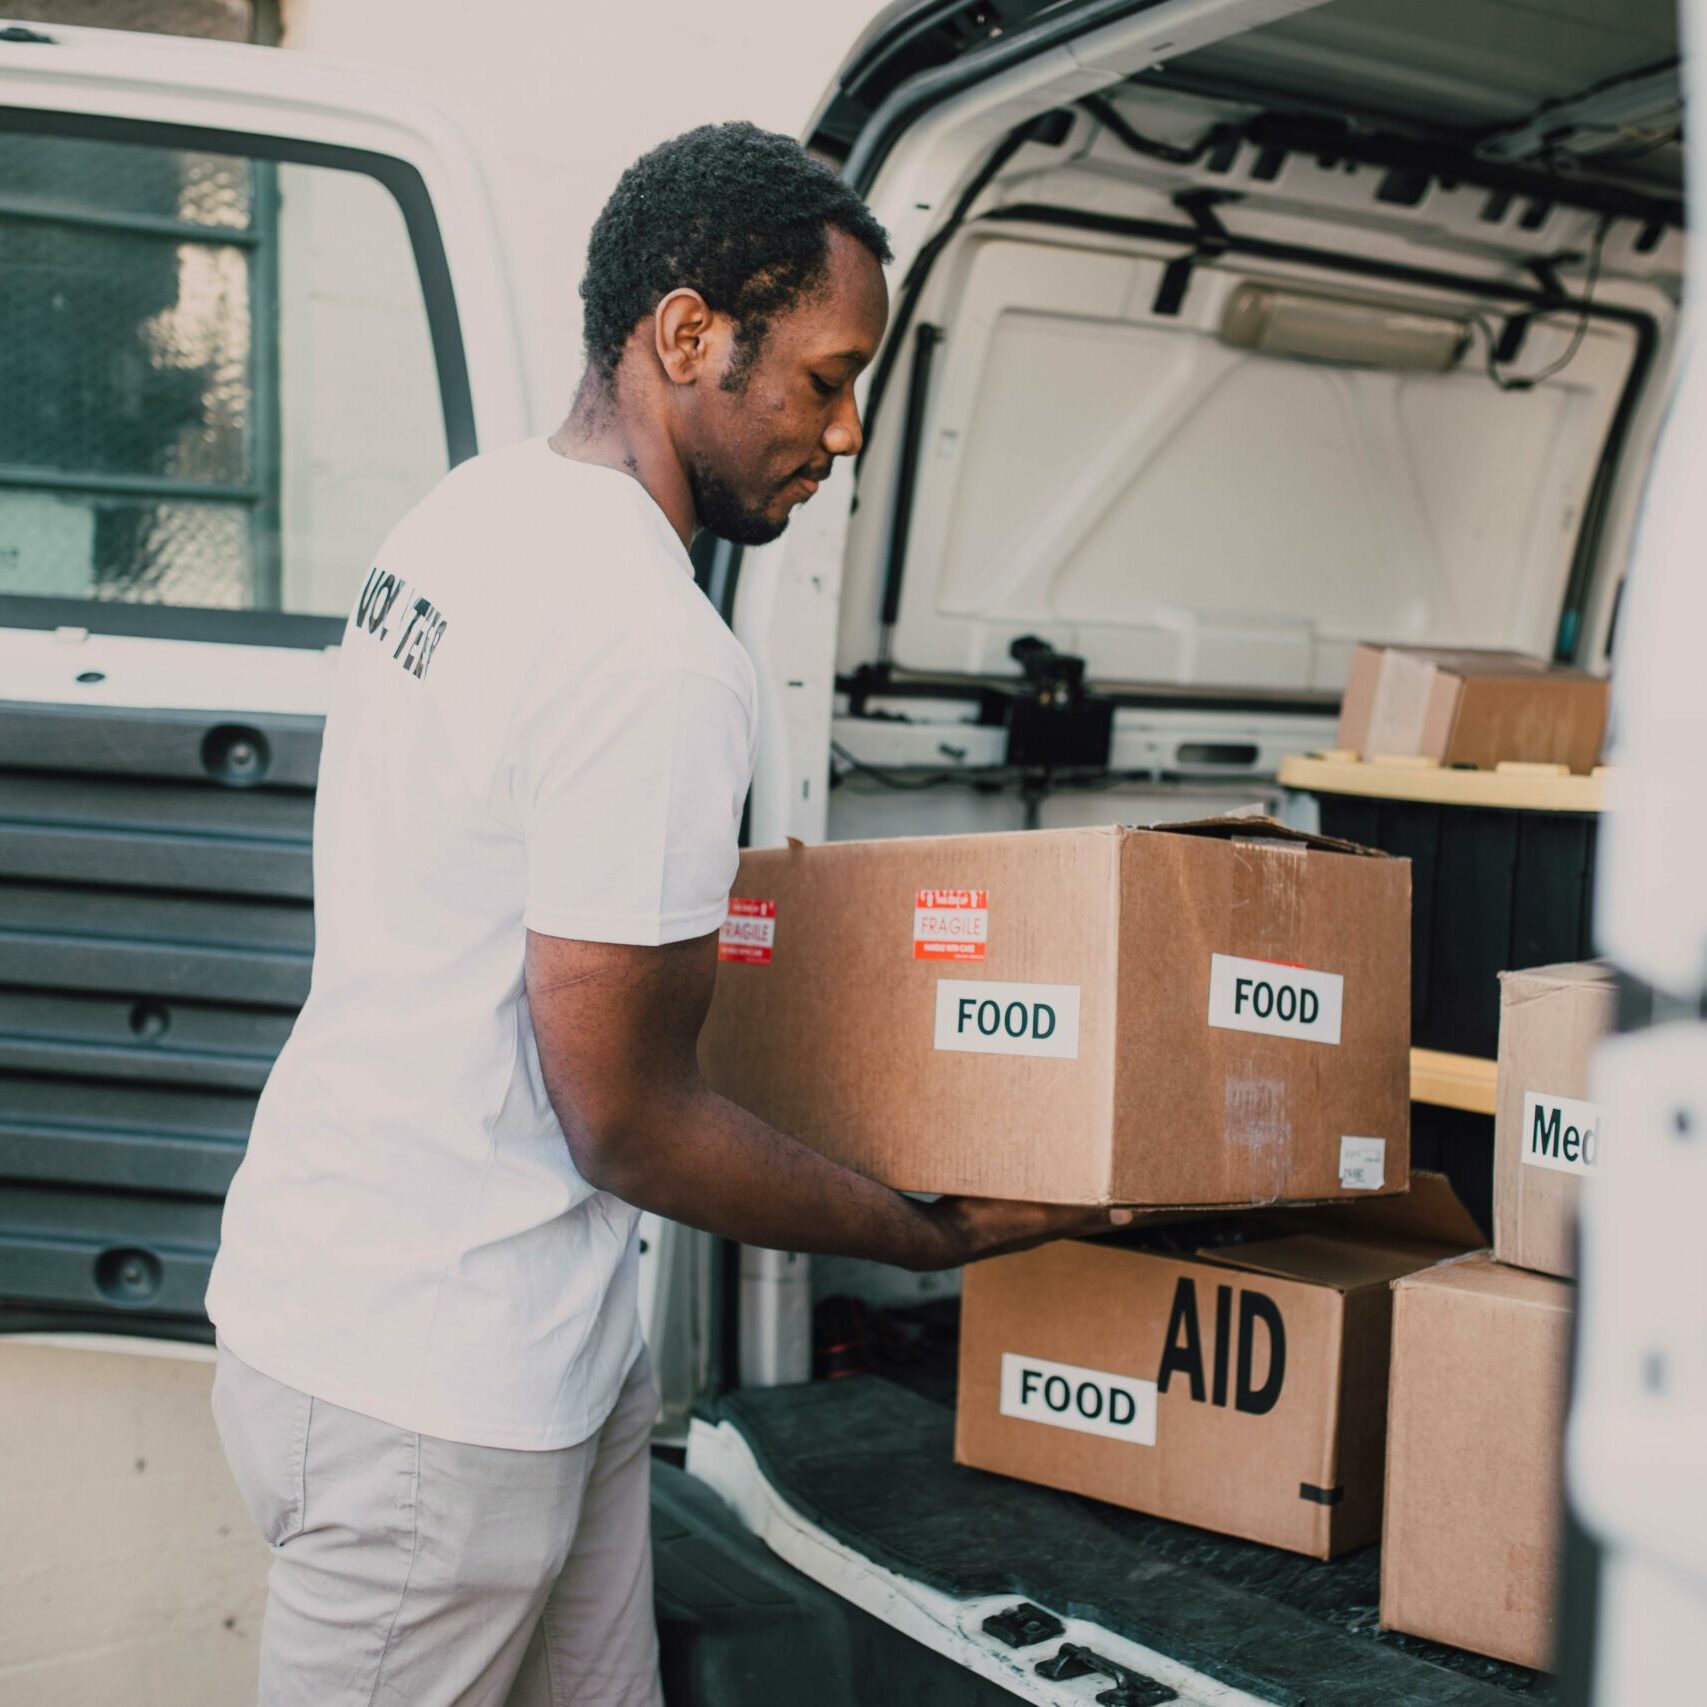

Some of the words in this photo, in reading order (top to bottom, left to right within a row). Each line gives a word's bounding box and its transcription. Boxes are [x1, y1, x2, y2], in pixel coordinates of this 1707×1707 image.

[920, 916, 982, 936] FRAGILE
[957, 998, 1056, 1040] FOOD
[1234, 977, 1319, 1024] FOOD
[1157, 1276, 1287, 1415] AID
[1021, 1368, 1136, 1425] FOOD
